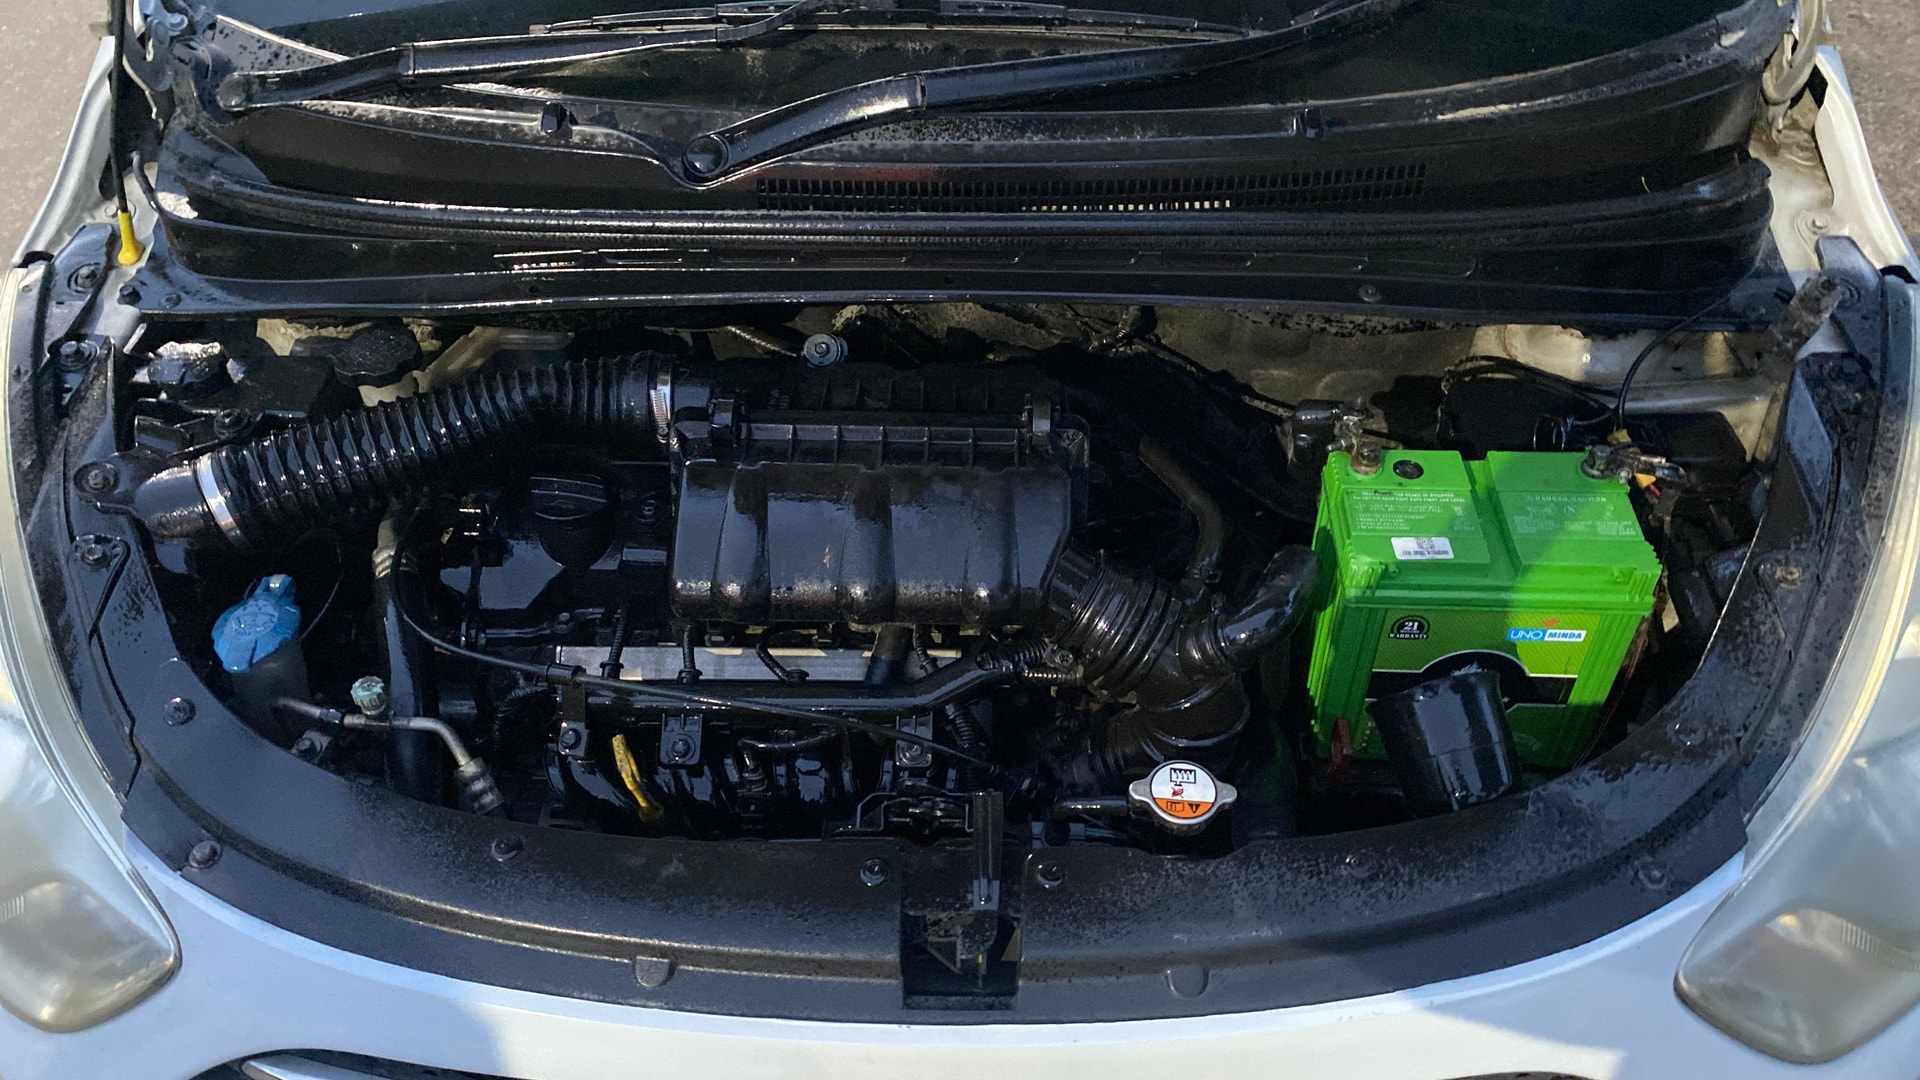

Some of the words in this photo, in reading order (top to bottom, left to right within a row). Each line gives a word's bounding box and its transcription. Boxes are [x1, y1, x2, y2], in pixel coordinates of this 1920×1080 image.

[1403, 621, 1419, 631] 21
[1510, 630, 1543, 640] UNO
[1547, 631, 1583, 640] MINDA
